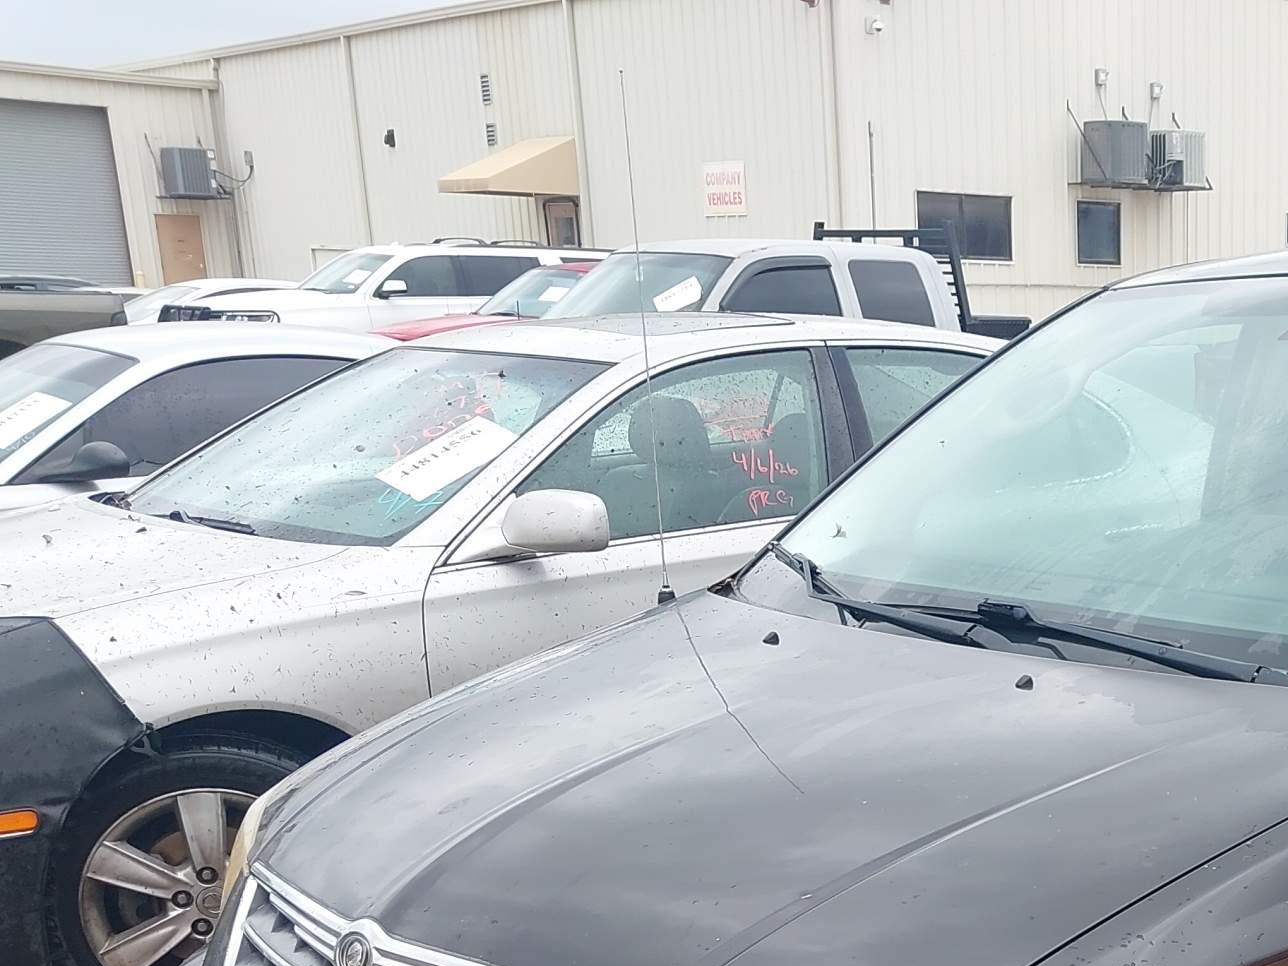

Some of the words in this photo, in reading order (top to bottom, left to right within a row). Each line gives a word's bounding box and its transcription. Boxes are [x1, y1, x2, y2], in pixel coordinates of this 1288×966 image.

[705, 171, 741, 186] COMPANY
[707, 191, 743, 206] VEHICLES
[731, 447, 799, 484] 4/6/26
